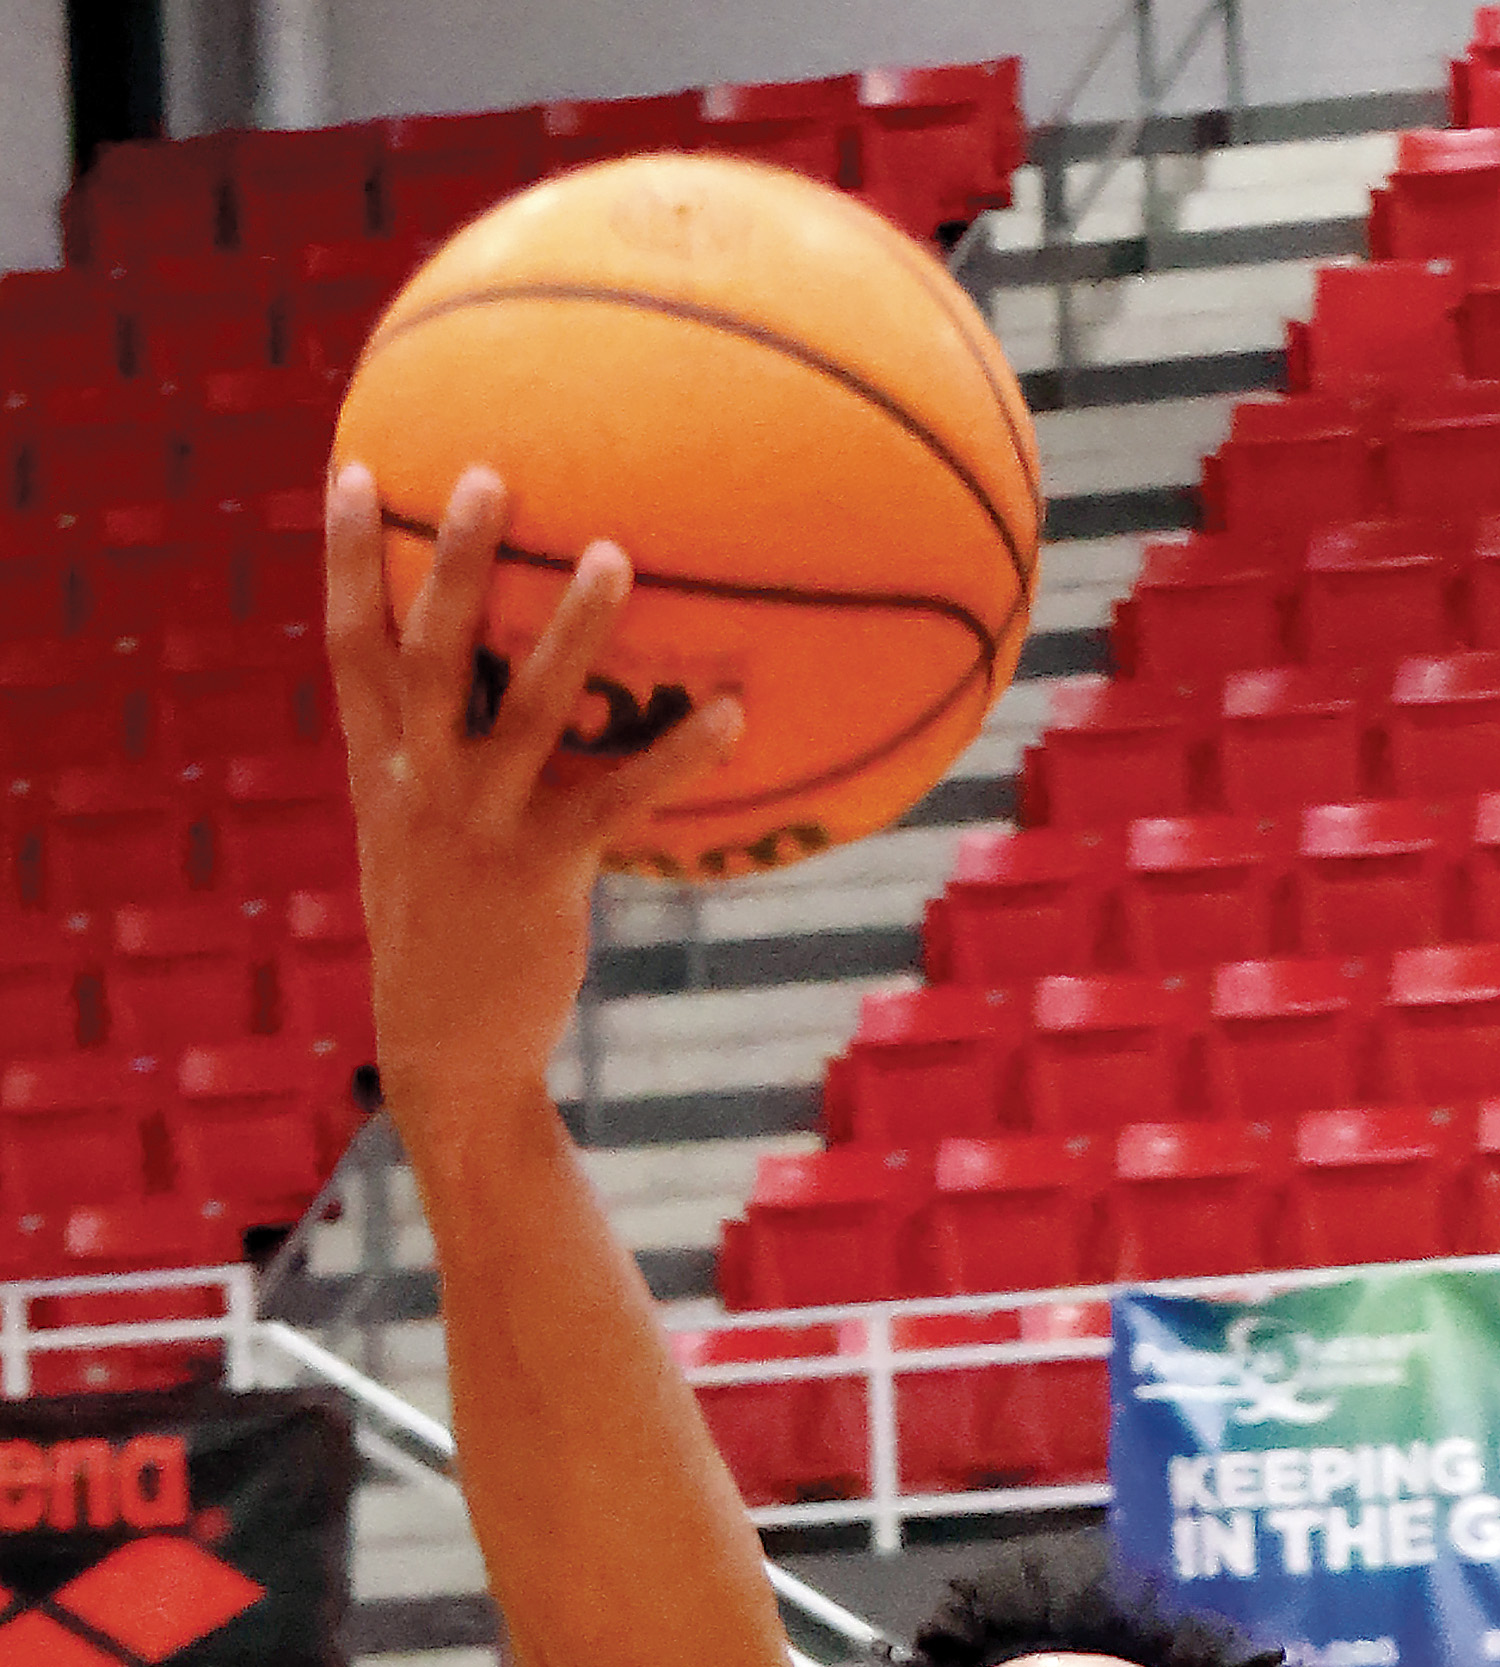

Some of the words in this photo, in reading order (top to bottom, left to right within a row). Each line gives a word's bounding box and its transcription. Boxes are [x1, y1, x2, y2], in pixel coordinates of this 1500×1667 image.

[1167, 1436, 1485, 1509] KEEPING
[1172, 1513, 1258, 1581] IN
[1271, 1495, 1438, 1576] THE
